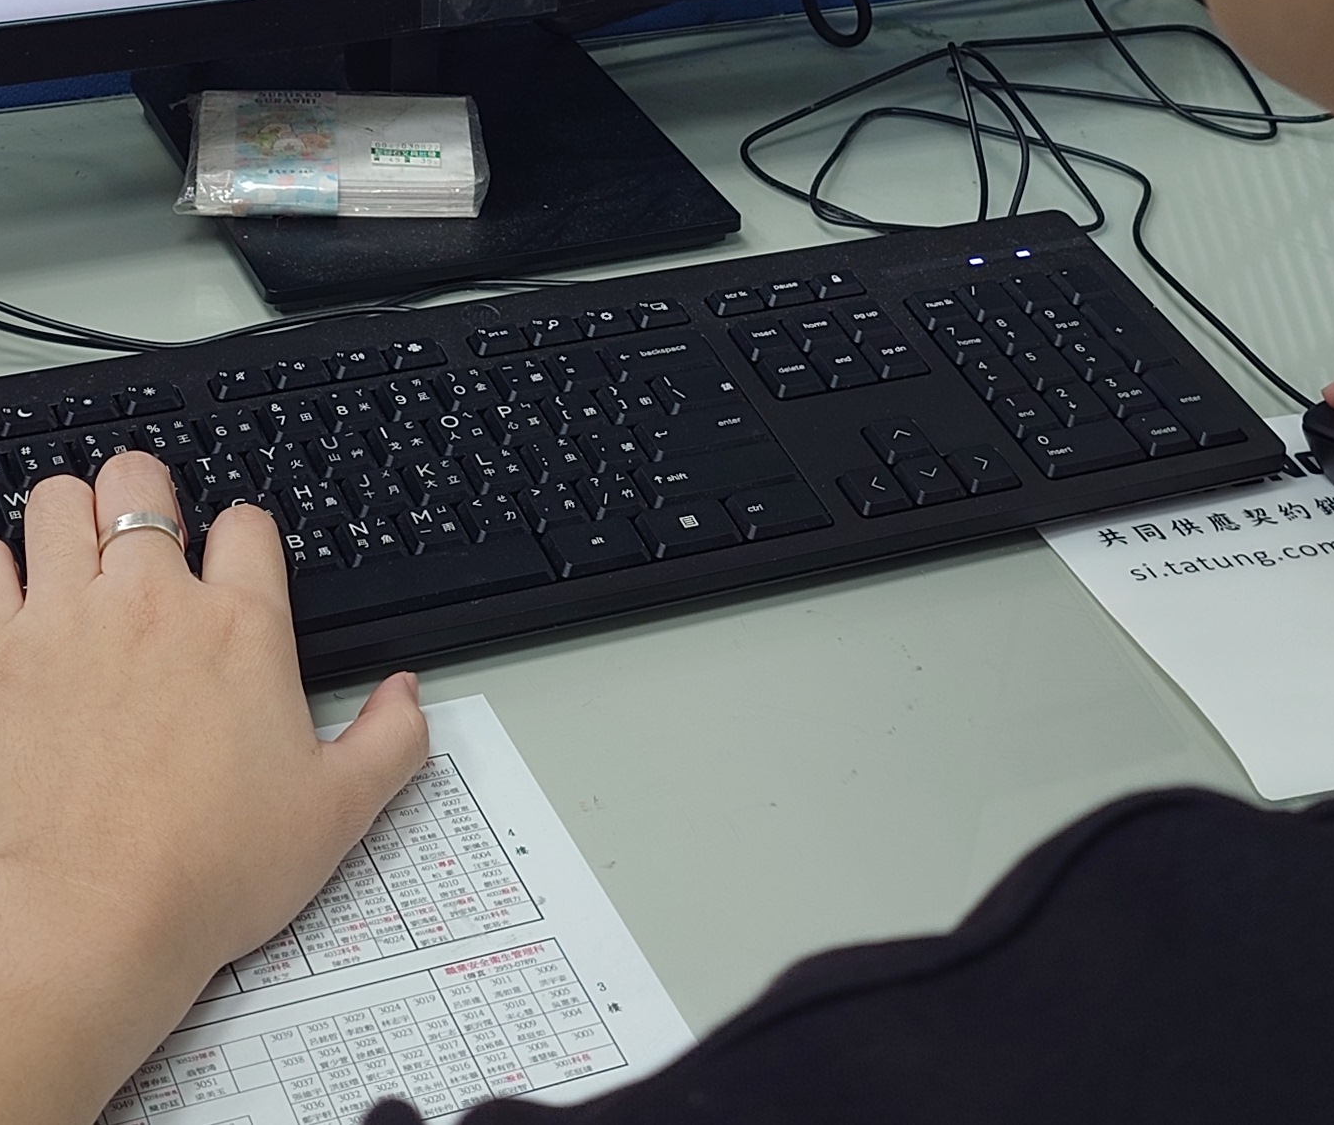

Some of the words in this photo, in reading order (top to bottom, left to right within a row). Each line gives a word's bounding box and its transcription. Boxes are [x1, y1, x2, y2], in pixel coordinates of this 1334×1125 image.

[803, 320, 827, 329] home
[751, 329, 777, 338] insert
[639, 343, 687, 357] backspace
[835, 356, 852, 364] end
[778, 364, 805, 373] delete
[717, 415, 741, 427] enter
[416, 463, 435, 477] K
[667, 473, 689, 482] shift
[293, 485, 313, 500] H
[747, 504, 764, 513] ctrl
[410, 510, 433, 524] M
[348, 521, 369, 536] N
[286, 534, 304, 549] B
[591, 536, 605, 545] alt
[399, 808, 420, 817] 4014
[508, 828, 516, 837] 4
[379, 852, 400, 861] 4020
[383, 935, 405, 945] 4024
[491, 976, 512, 986] 3011
[597, 982, 607, 991] 3
[413, 995, 436, 1006] 3019
[560, 1008, 583, 1019] 3004
[270, 1031, 294, 1043] 3039
[573, 1029, 595, 1040] 3003
